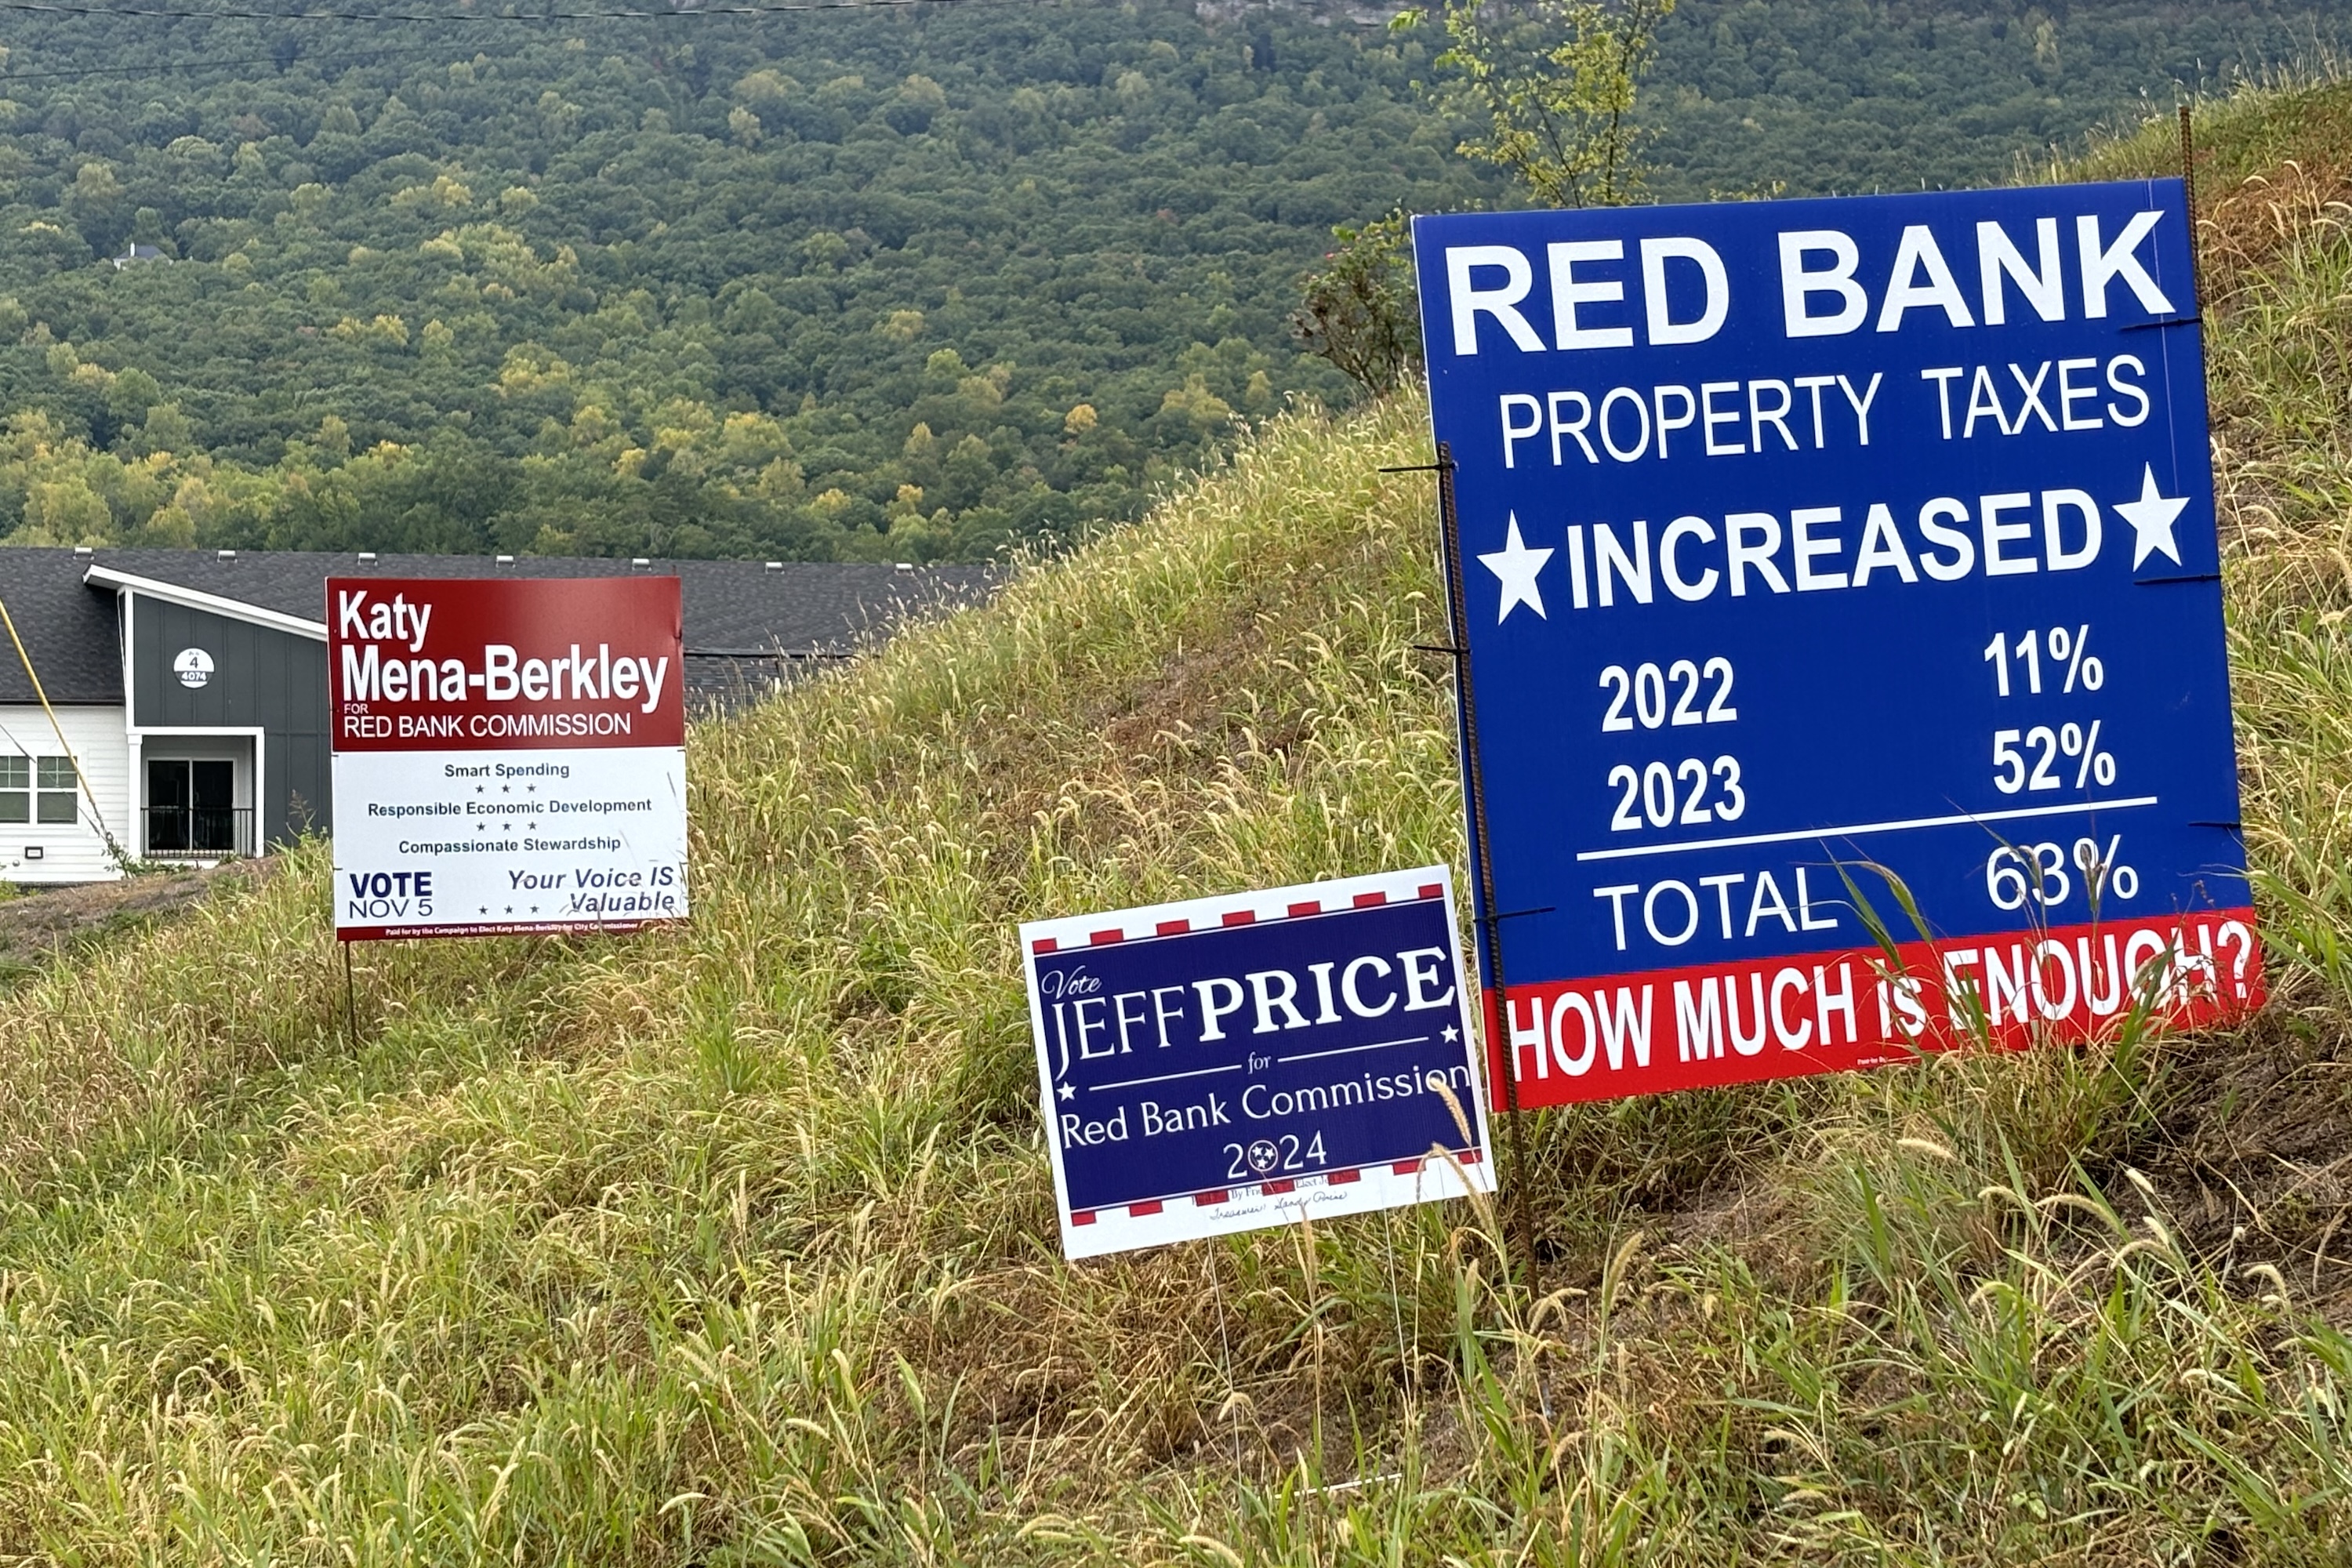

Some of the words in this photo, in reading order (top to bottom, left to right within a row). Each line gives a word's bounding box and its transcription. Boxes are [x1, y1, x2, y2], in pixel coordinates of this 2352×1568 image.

[1446, 236, 1730, 355] RED
[1777, 209, 2176, 338] BANK
[1500, 372, 1882, 469] PROPERTY
[1922, 354, 2149, 439] TAXES
[1566, 488, 2101, 608] INCREASED
[339, 590, 432, 653] Katy
[181, 671, 207, 681] 4074
[189, 656, 199, 670] 4
[342, 644, 669, 714] Mena-Berkley
[1598, 656, 1737, 732] 2022
[1984, 623, 2103, 696] 11%
[343, 703, 368, 714] FOR
[344, 715, 392, 739] RED
[399, 714, 464, 738] BANK
[470, 713, 631, 737] COMMISSION
[445, 764, 491, 778] Smart
[495, 763, 570, 779] Spending
[1607, 754, 1745, 832] 2023
[1992, 719, 2116, 795] 52%
[368, 802, 462, 818] Responsible
[466, 800, 544, 815] Economic
[550, 799, 652, 815] Development
[399, 839, 518, 856] Compassionate
[524, 837, 621, 853] Stewardship
[350, 872, 433, 898] VOTE
[508, 869, 567, 890] Your
[575, 868, 642, 888] Voice
[650, 866, 674, 886] IS
[570, 891, 675, 913] Valuable
[1593, 866, 1838, 950] TOTAL
[1987, 834, 2138, 910] 63%
[350, 899, 409, 919] NOV
[418, 898, 433, 916] 5
[385, 927, 401, 936] Paid
[434, 926, 469, 935] Campaign
[1041, 965, 1102, 1000] Vote
[1507, 985, 1653, 1082] HOW
[1673, 963, 1857, 1062] MUCH
[1944, 920, 2252, 1031] ENOUGH?
[1247, 1053, 1272, 1074] for
[1061, 1106, 1128, 1149] Red
[1142, 1094, 1231, 1137] Bank
[1242, 1065, 1471, 1120] Commission
